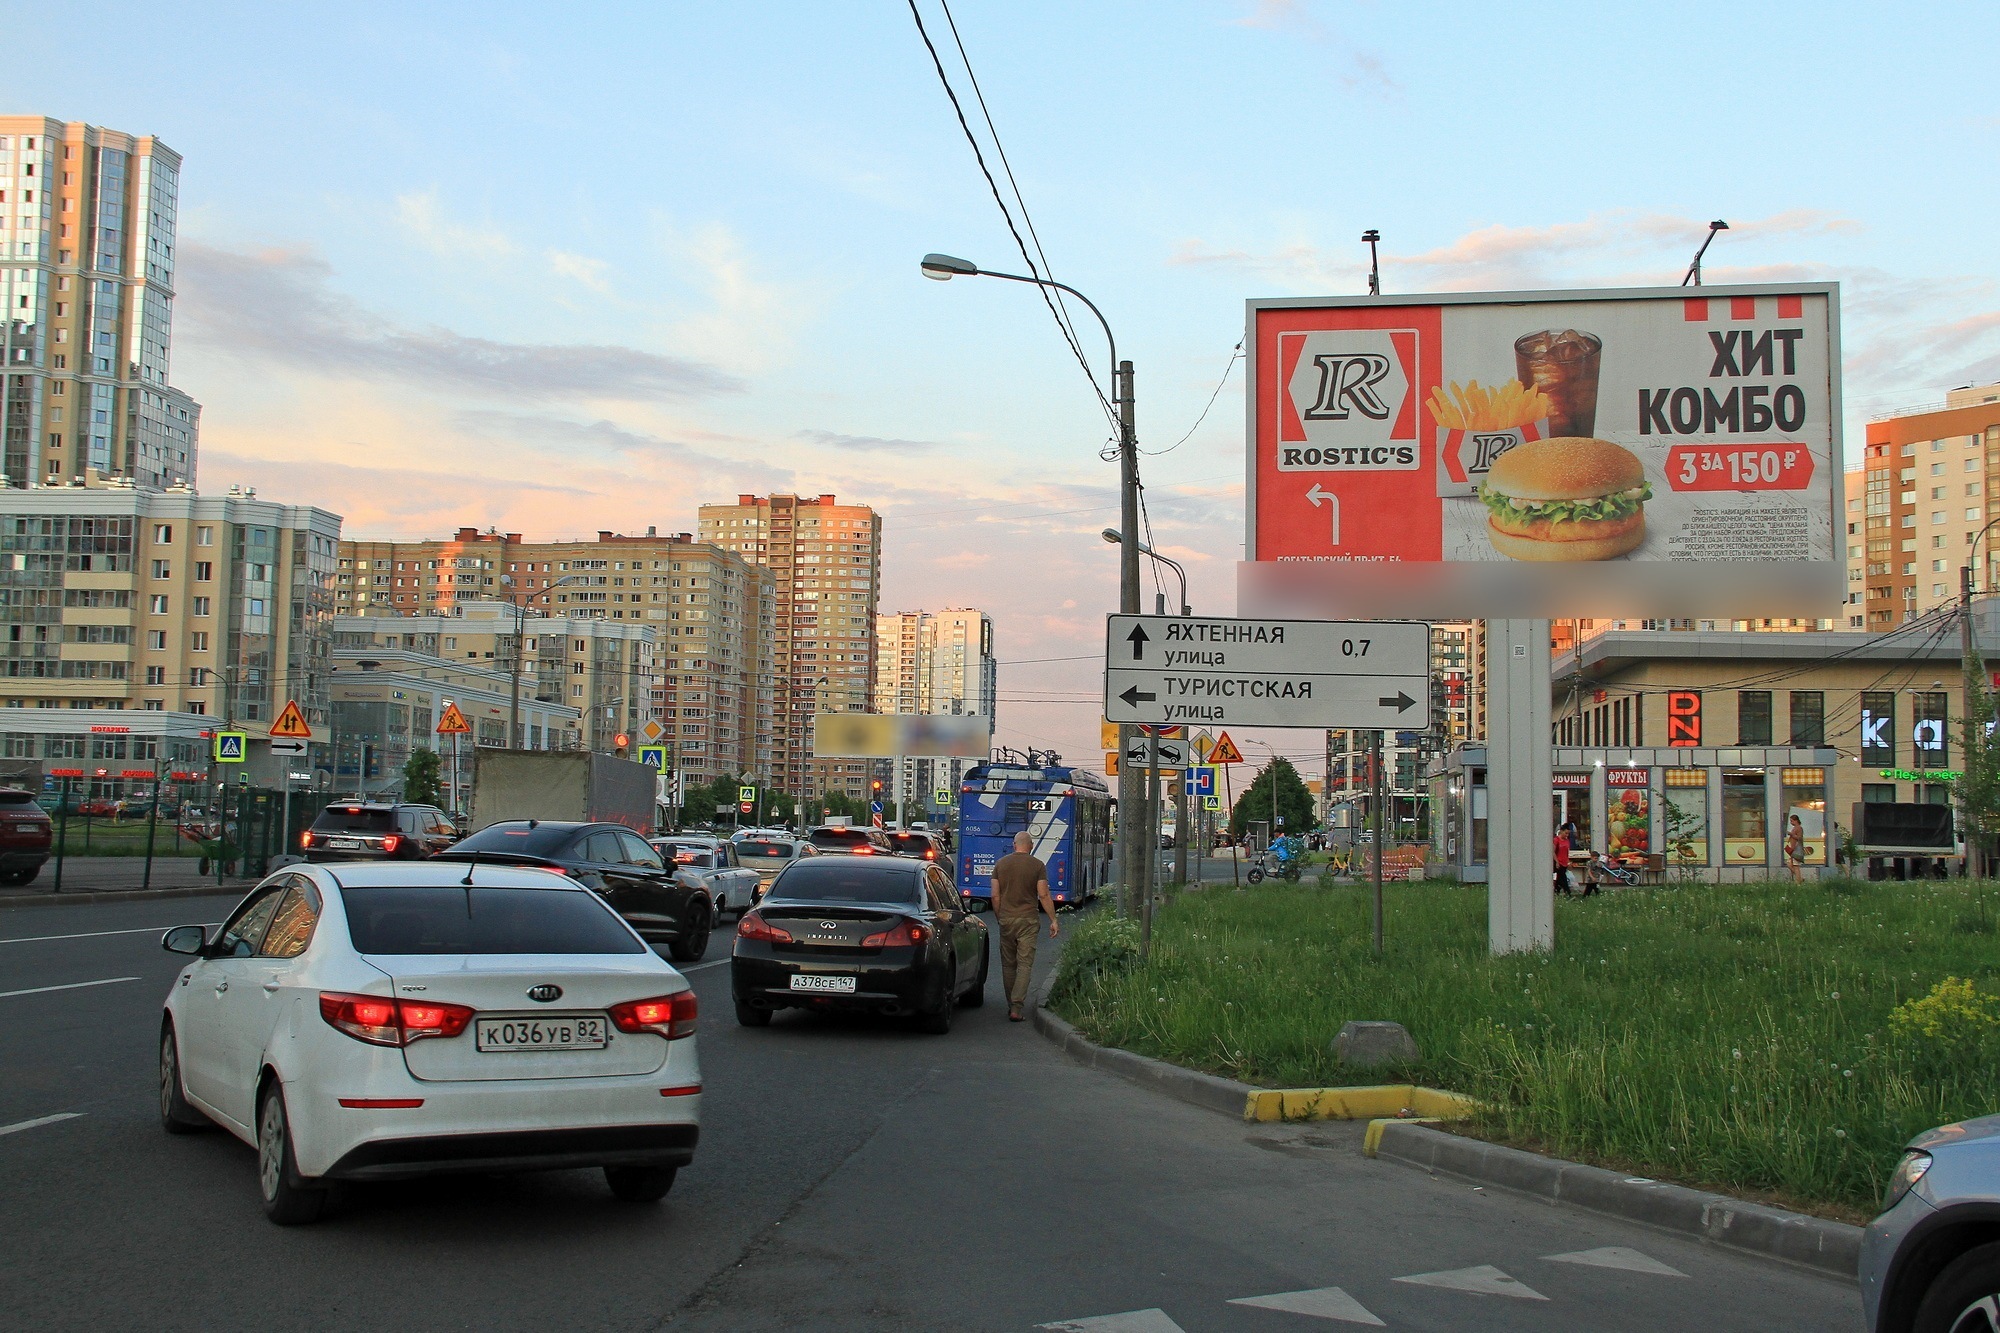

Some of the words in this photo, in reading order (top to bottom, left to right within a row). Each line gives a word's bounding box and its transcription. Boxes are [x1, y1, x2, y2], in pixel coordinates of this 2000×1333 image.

[1708, 329, 1803, 377] ХИТ
[1638, 385, 1806, 435] КОМБО
[1284, 447, 1414, 466] ROSTIC'S
[1679, 452, 1698, 484] 3
[1727, 450, 1780, 484] 150
[1166, 624, 1284, 644] ЯХТЕННАЯ
[1164, 648, 1225, 667] улица
[1342, 639, 1371, 659] 0,7
[1164, 678, 1312, 699] ТУРИСТСКАЯ
[1164, 702, 1224, 720] улица
[1669, 692, 1700, 748] DN
[1608, 771, 1646, 784] ФРУКТЫ
[1031, 801, 1046, 810] 23
[534, 988, 558, 998] KIA
[578, 1021, 598, 1036] 82
